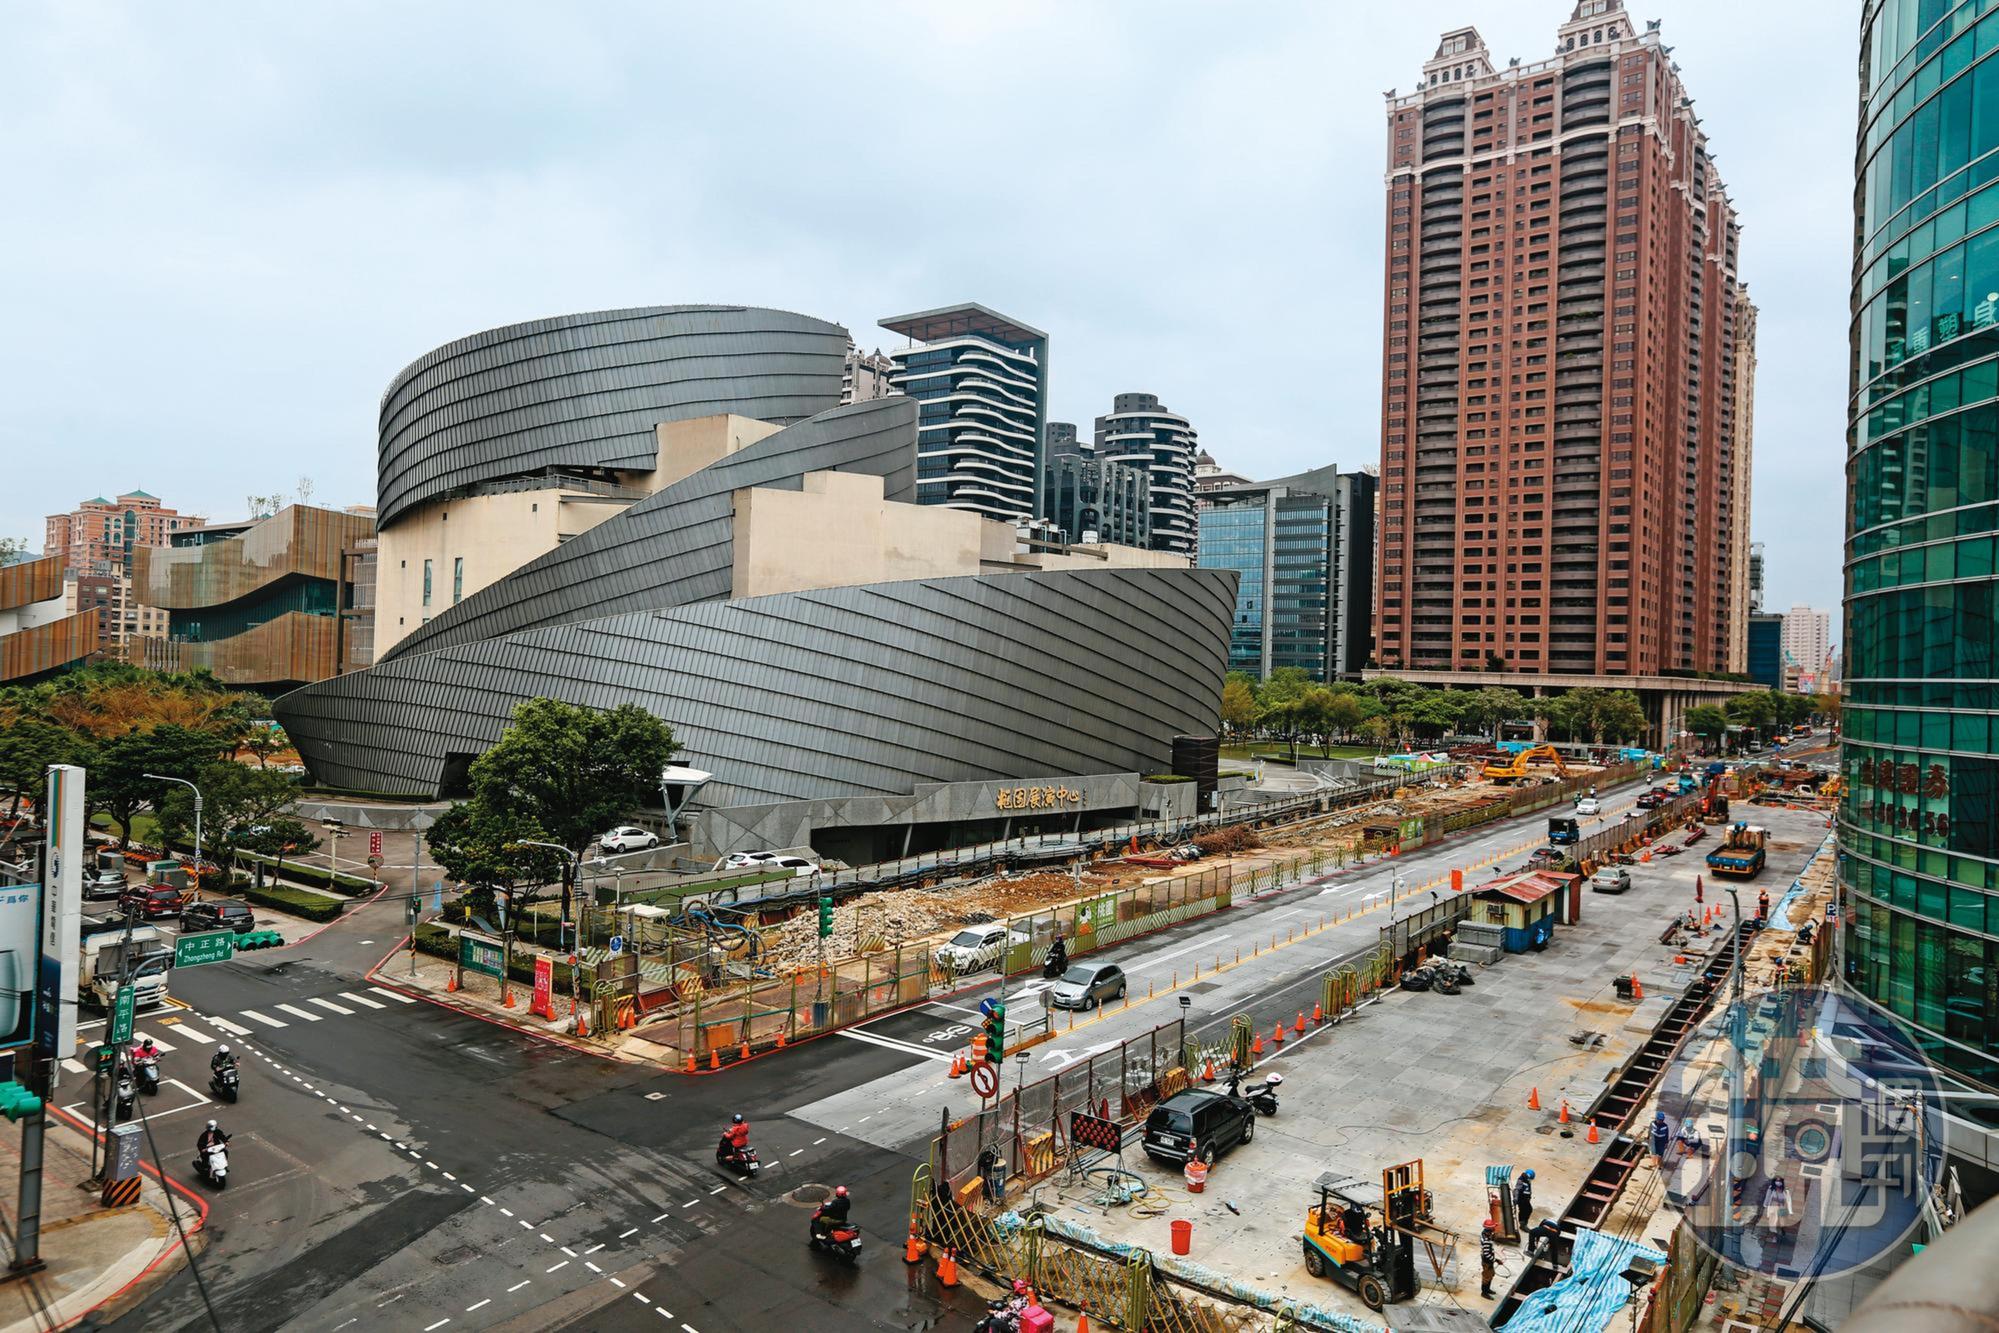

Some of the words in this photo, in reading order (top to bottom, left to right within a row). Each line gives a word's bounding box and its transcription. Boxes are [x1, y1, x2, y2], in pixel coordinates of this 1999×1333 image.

[997, 784, 1080, 809] 桃園展演中心
[184, 936, 225, 951] 中正路
[183, 952, 216, 963] Zhongzheng
[216, 949, 224, 958] Rd
[117, 995, 131, 1035] 南平路
